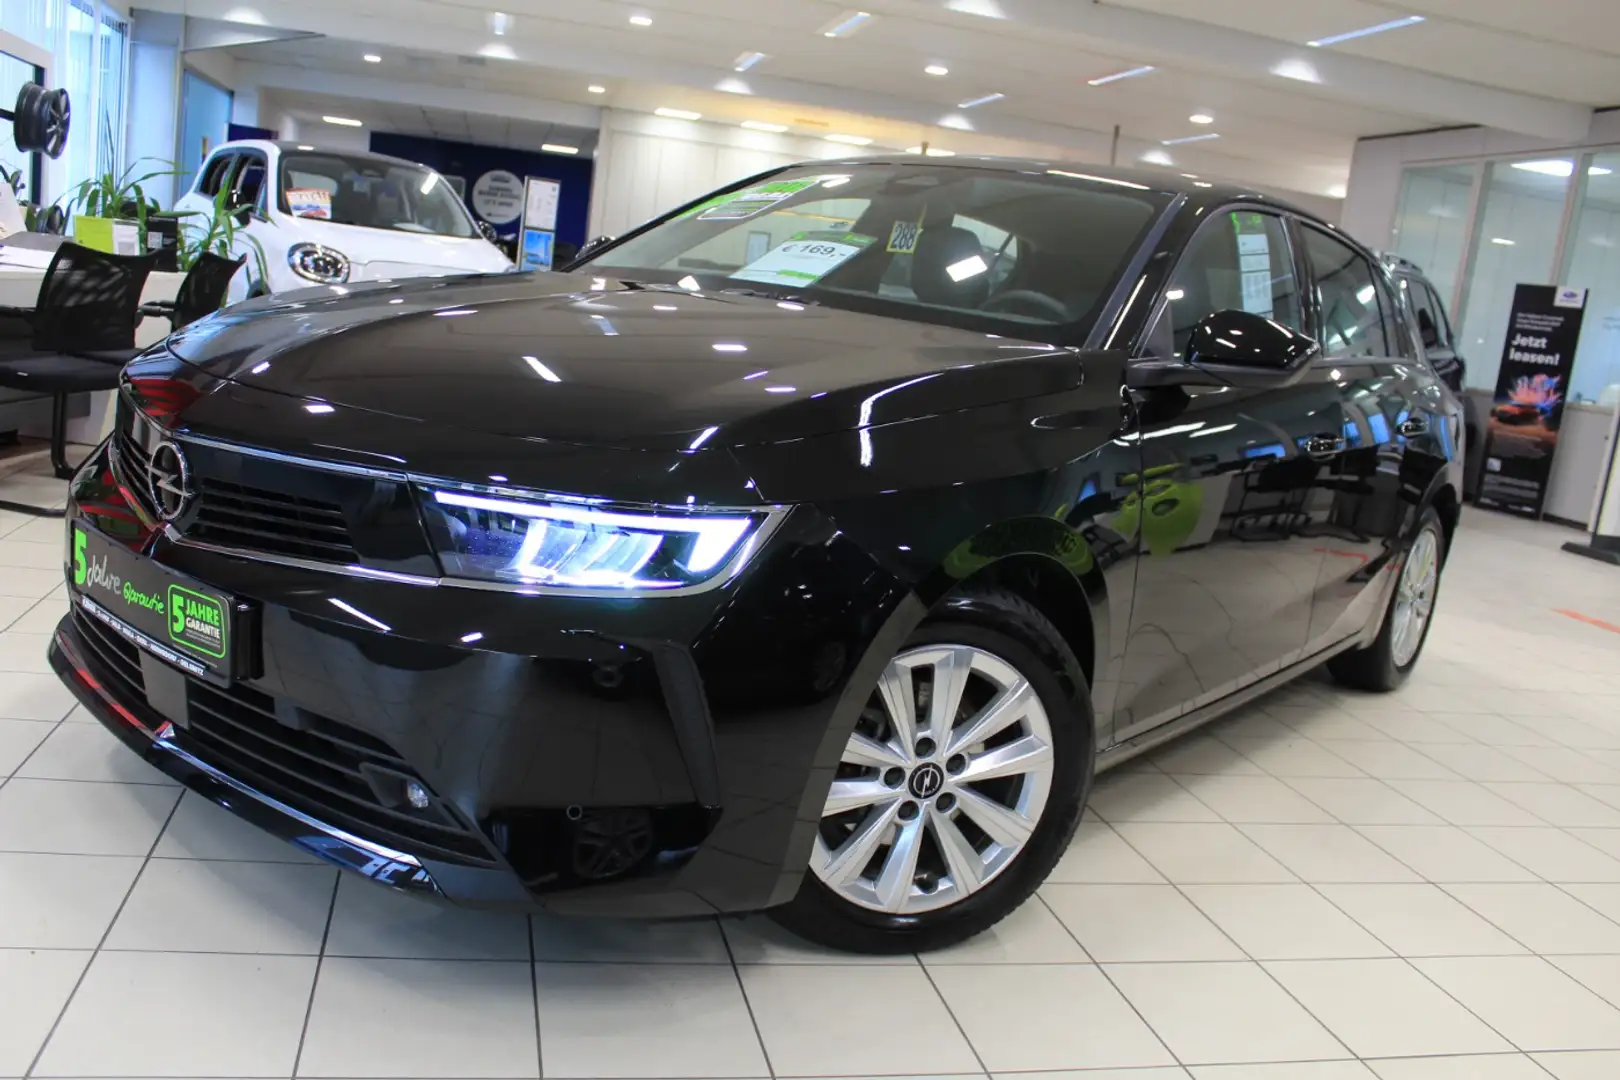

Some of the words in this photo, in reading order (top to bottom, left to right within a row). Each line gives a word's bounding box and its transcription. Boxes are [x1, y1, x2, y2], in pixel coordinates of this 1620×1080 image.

[890, 223, 917, 249] 288
[1511, 334, 1548, 349] Jetzt
[1509, 348, 1560, 365] leasen!
[75, 528, 86, 584] 5
[87, 555, 121, 594] Jahre
[172, 594, 185, 633] 5
[186, 599, 219, 626] JAHRE
[186, 617, 220, 639] GARANTIE
